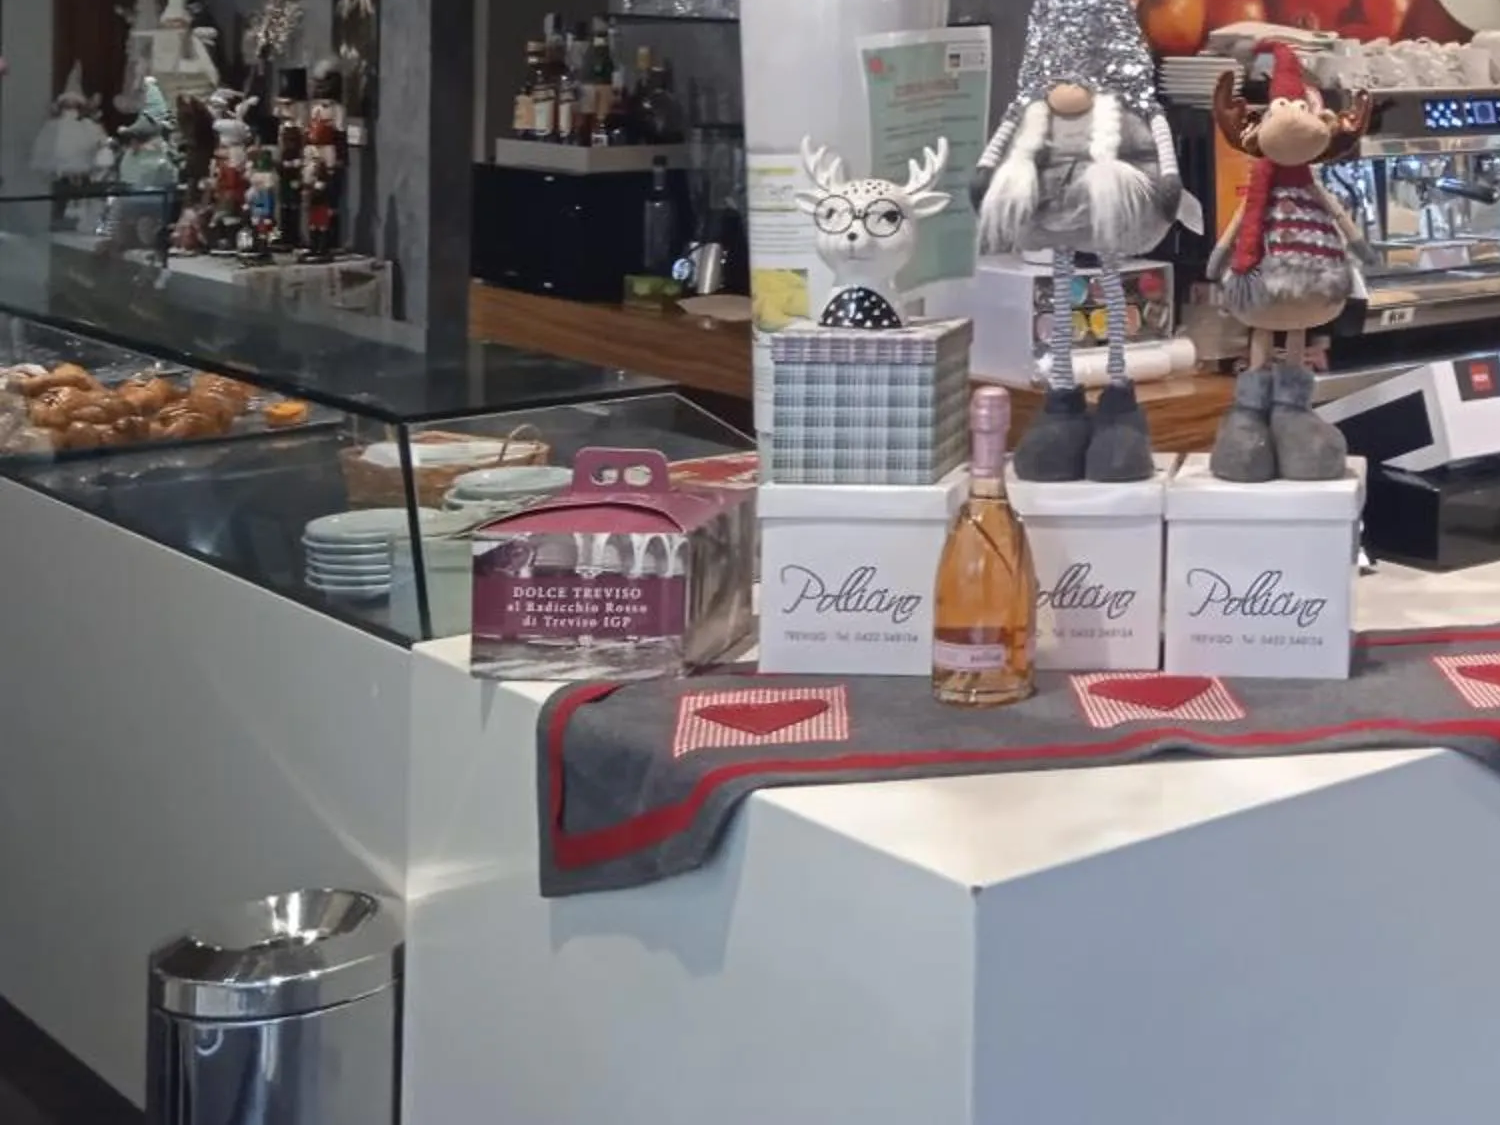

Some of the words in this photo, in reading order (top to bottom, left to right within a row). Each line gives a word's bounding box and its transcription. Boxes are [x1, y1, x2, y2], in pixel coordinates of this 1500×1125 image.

[512, 586, 568, 598] DOLCE
[572, 587, 642, 600] TREVISO
[526, 601, 599, 613] Radicchio
[605, 602, 648, 613] Rosso
[522, 615, 537, 627] di
[543, 616, 598, 627] Treviso
[603, 616, 631, 628] IGP
